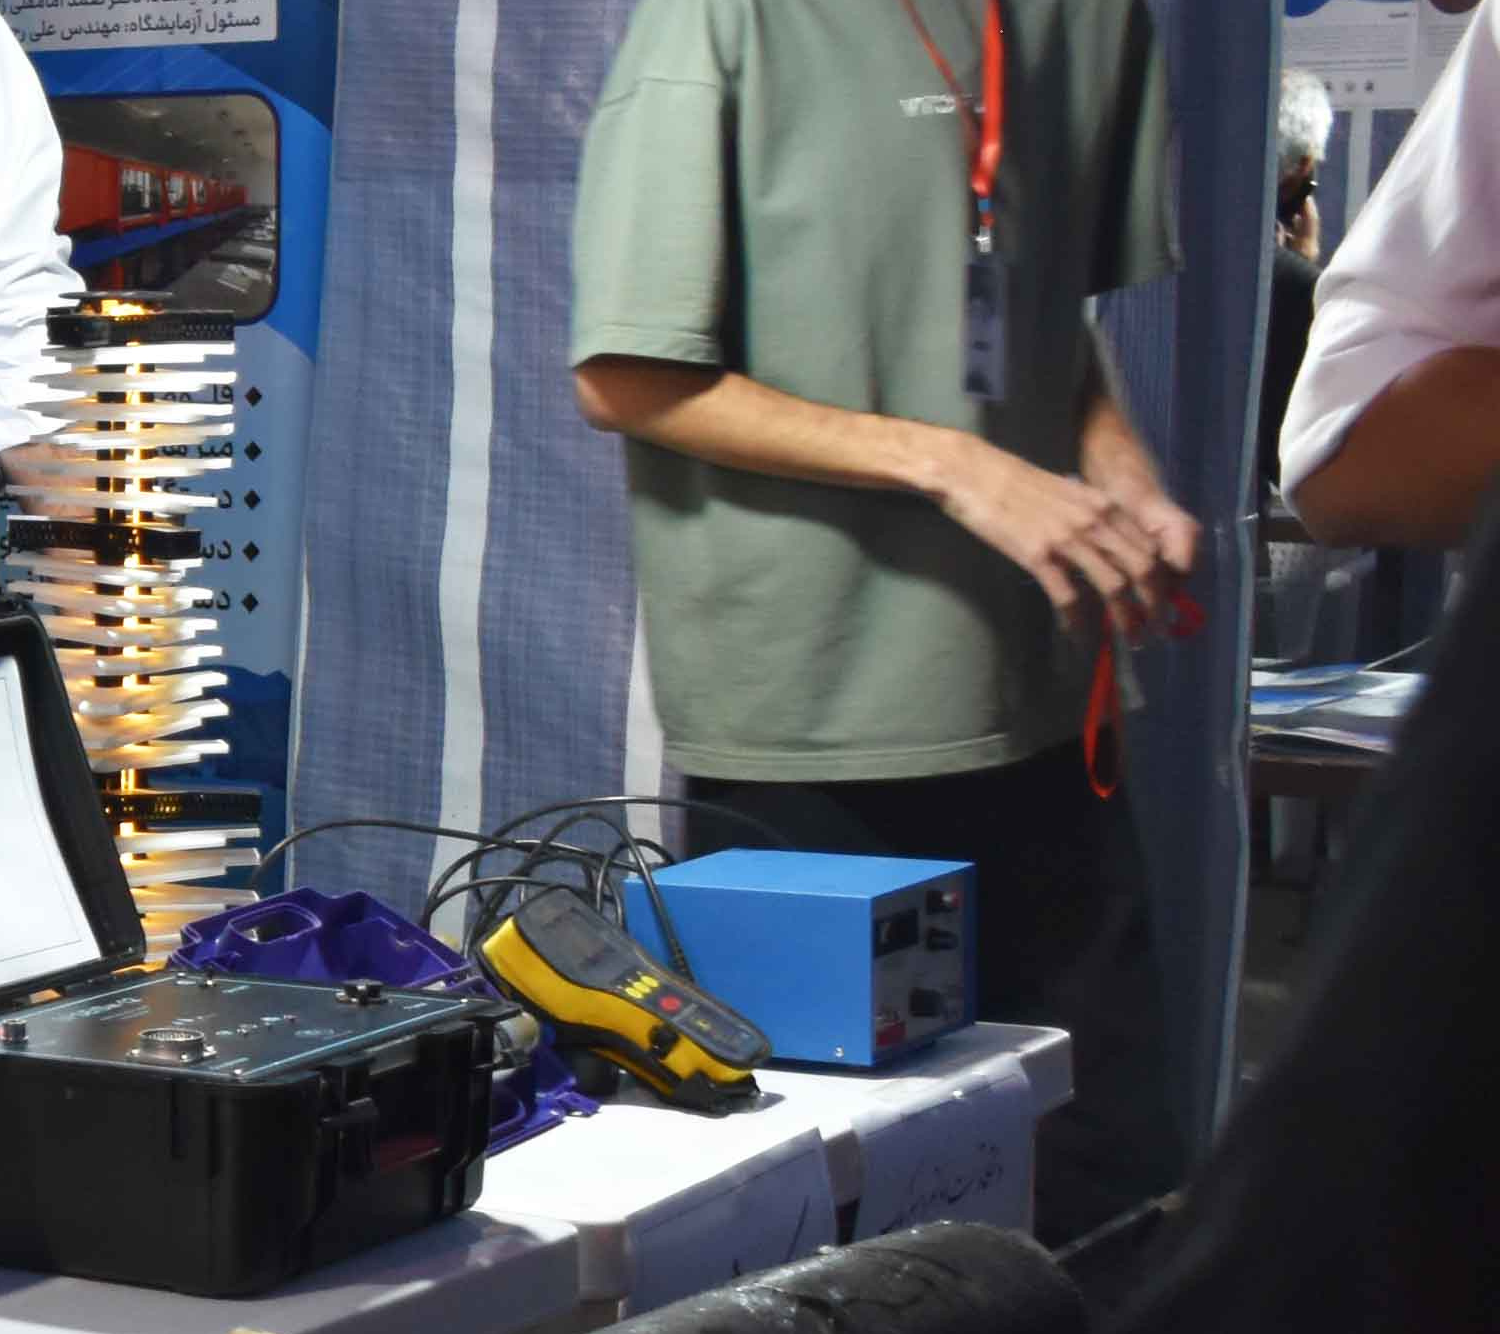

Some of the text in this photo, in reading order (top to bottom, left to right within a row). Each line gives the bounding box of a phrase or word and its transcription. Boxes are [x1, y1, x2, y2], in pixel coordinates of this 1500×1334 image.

[29, 19, 58, 42] علی
[60, 21, 121, 42] مهندس
[204, 14, 261, 34] مسئول
